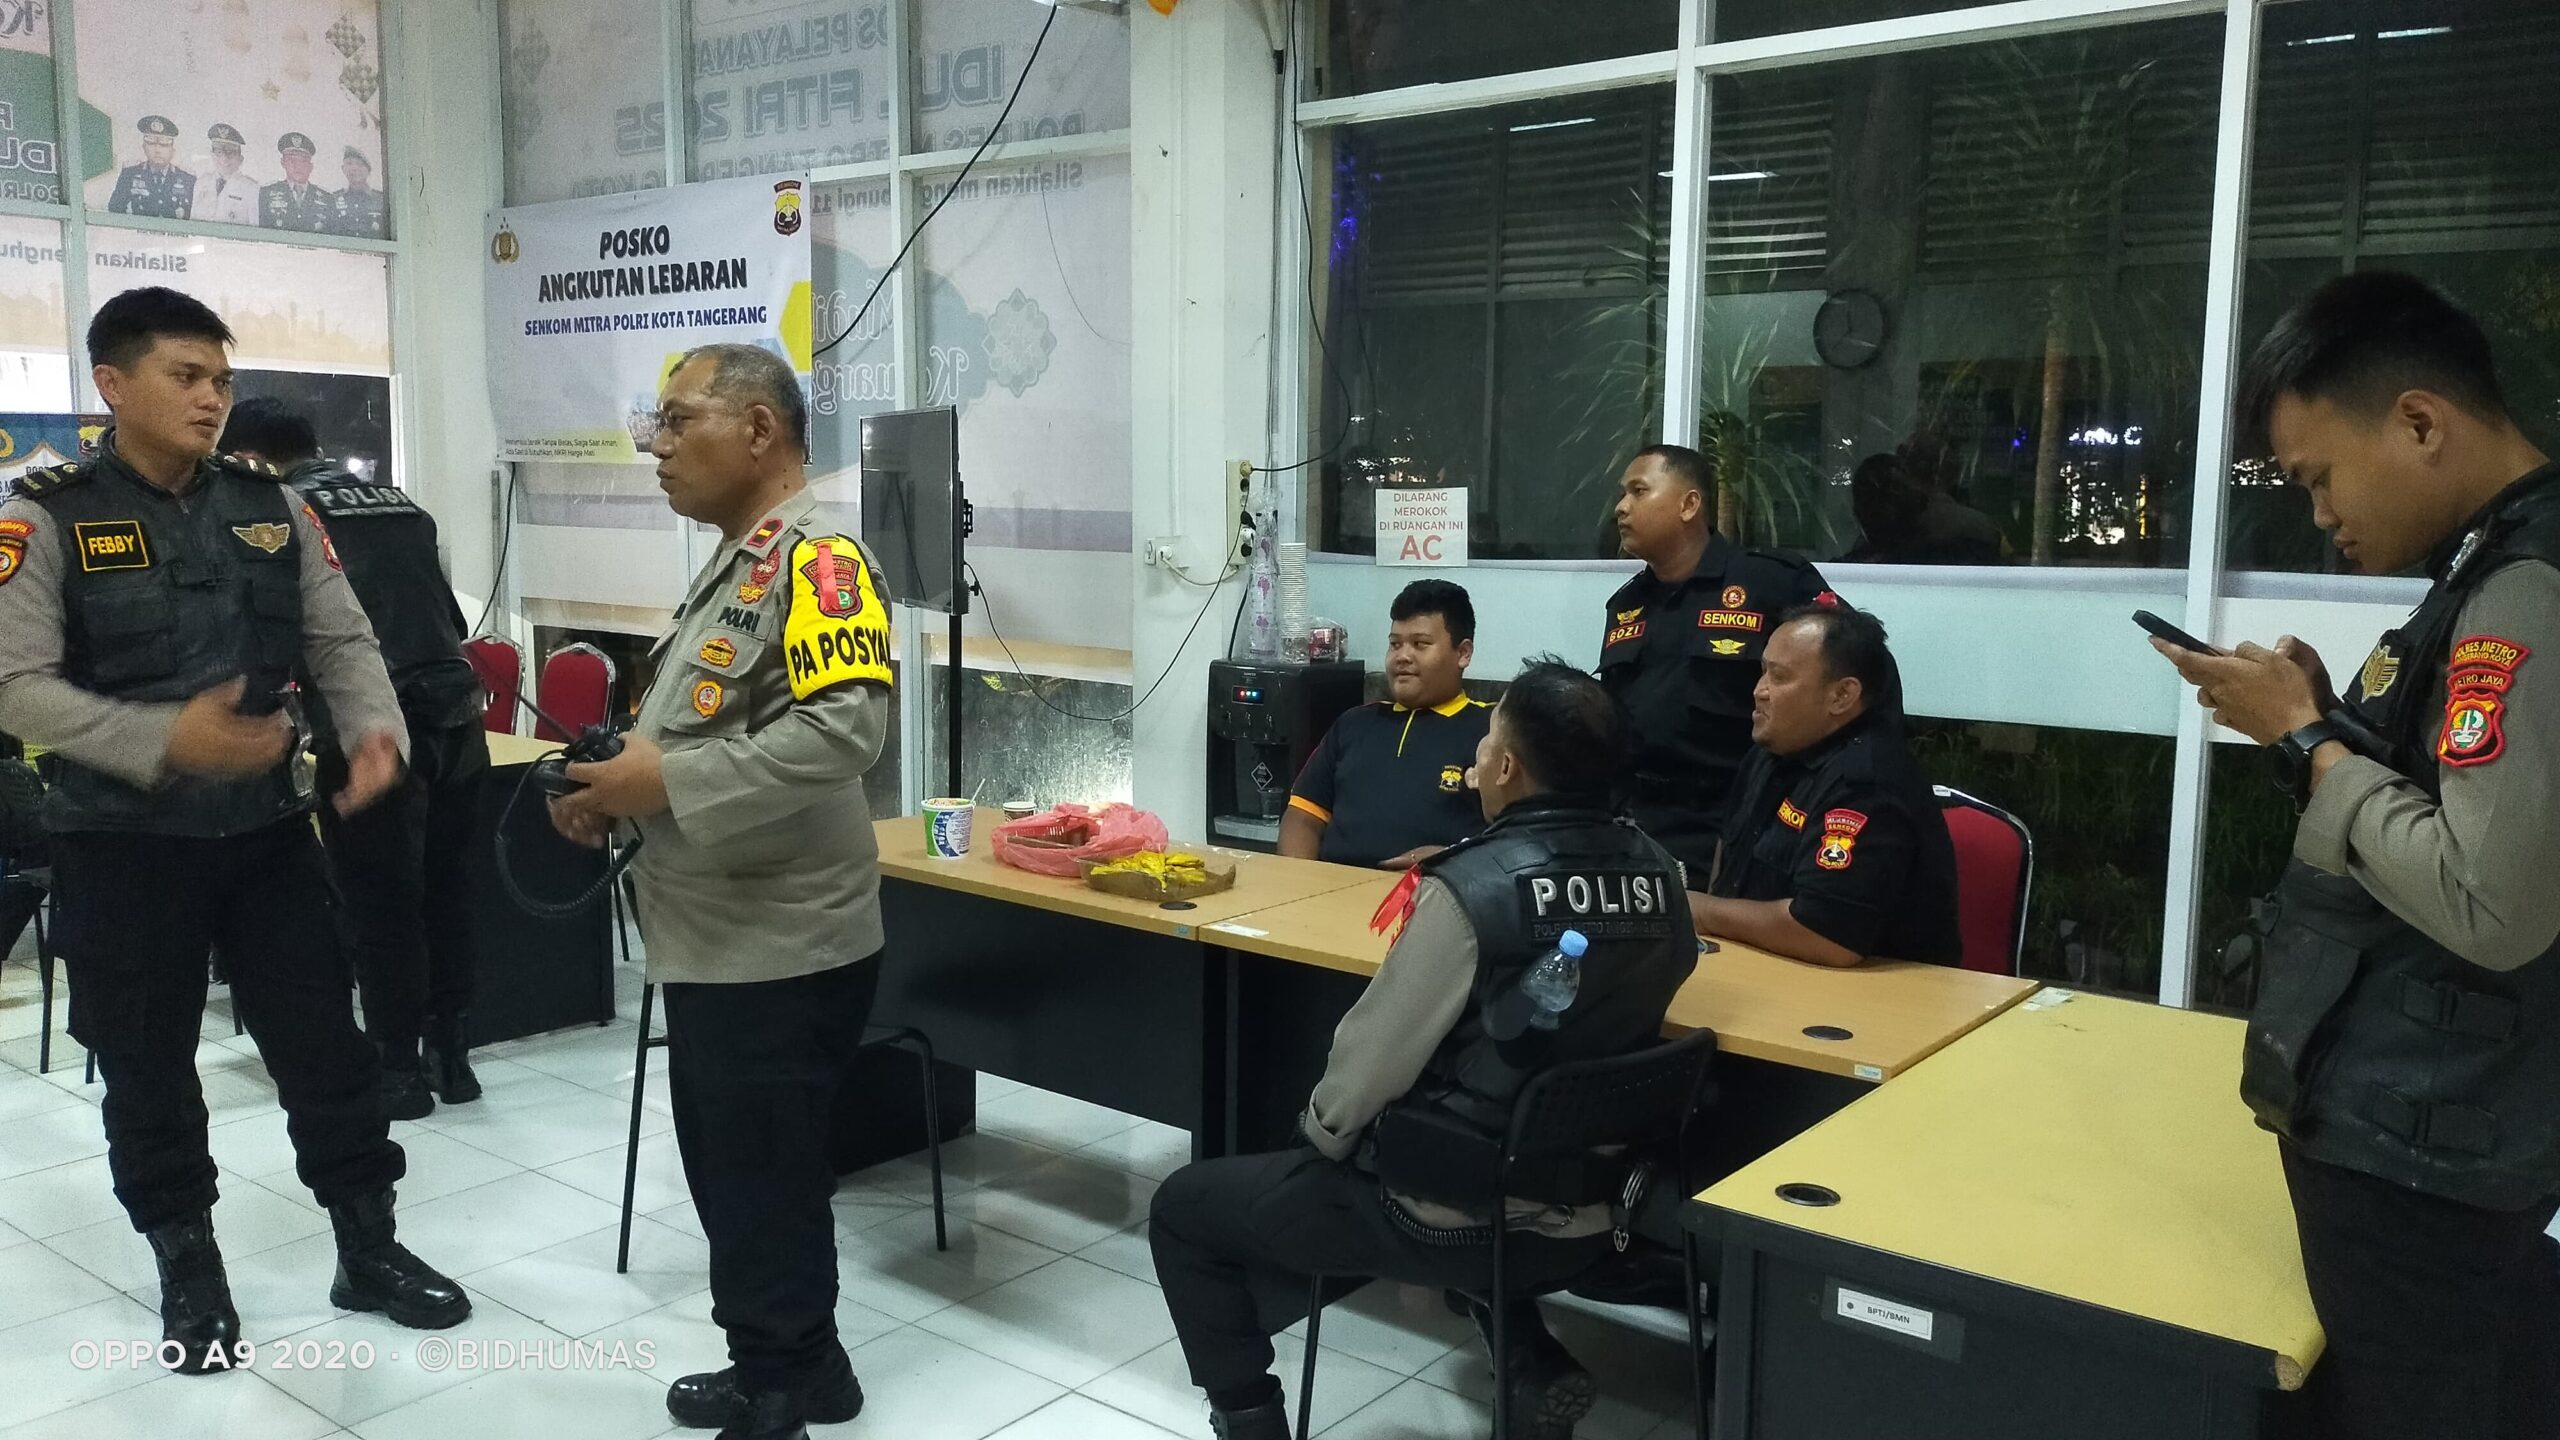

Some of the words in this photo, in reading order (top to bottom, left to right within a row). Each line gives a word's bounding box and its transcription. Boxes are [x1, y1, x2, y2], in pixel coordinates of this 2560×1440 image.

[599, 224, 671, 260] POSKO
[538, 265, 645, 303] ANGKUTAN
[648, 257, 748, 295] LEBARAN
[525, 317, 571, 336] SENKOM
[574, 314, 611, 334] MITRA
[614, 312, 649, 331] POLRI
[652, 309, 685, 329] KOTA
[687, 305, 767, 327] TANGERANG
[1393, 492, 1448, 502] DILARANG
[1394, 506, 1448, 516] MEROKOK
[1379, 521, 1390, 531] DI
[1393, 521, 1446, 531] RUANGAN
[1449, 521, 1464, 530] INI
[87, 534, 134, 557] FEBBY
[1399, 534, 1442, 561] AC
[717, 606, 761, 634] POLRI
[1703, 612, 1758, 629] SENKOM
[788, 639, 819, 685] PA
[2480, 640, 2518, 660] METRO
[2480, 674, 2505, 687] JAYA
[1531, 875, 1666, 917] POLISI
